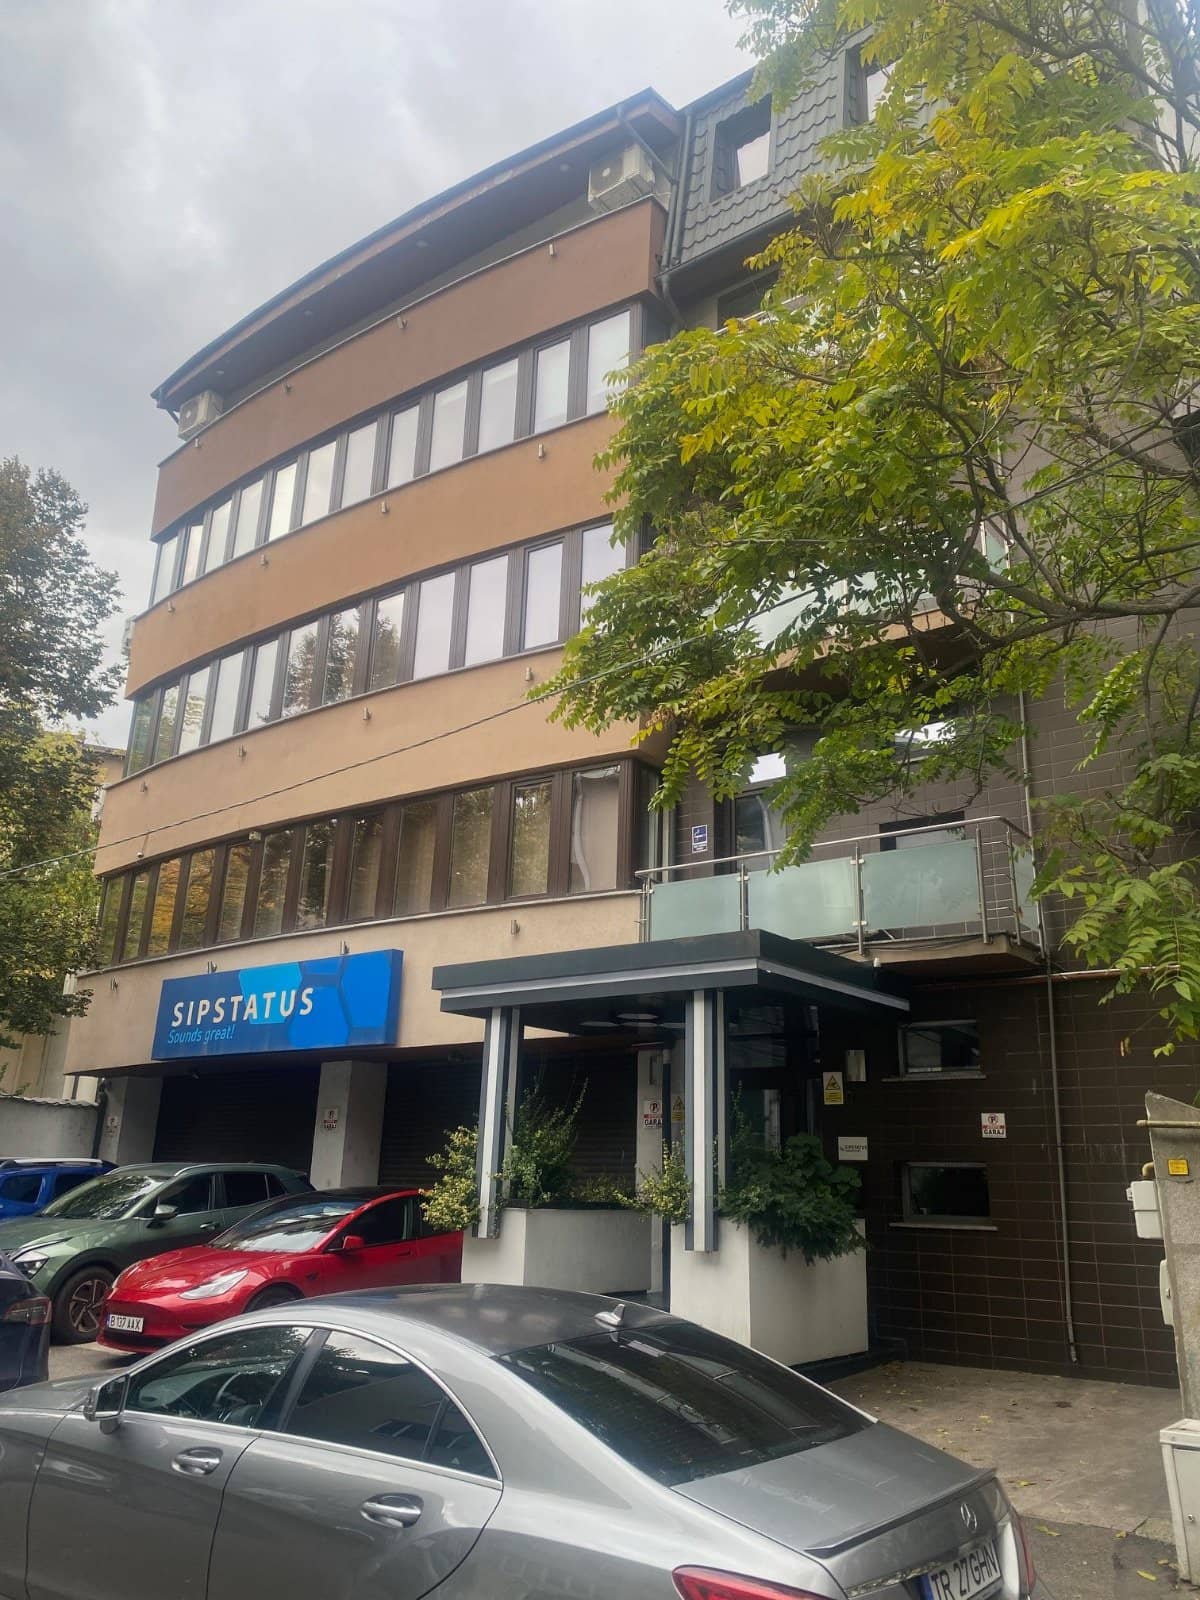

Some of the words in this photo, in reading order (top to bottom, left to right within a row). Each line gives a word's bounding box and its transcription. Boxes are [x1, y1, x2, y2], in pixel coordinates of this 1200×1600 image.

[171, 987, 314, 1027] SIPSTATUS
[167, 1027, 202, 1044] Sounds
[203, 1023, 236, 1045] great!
[110, 1315, 116, 1327] B
[930, 1569, 956, 1600] TR
